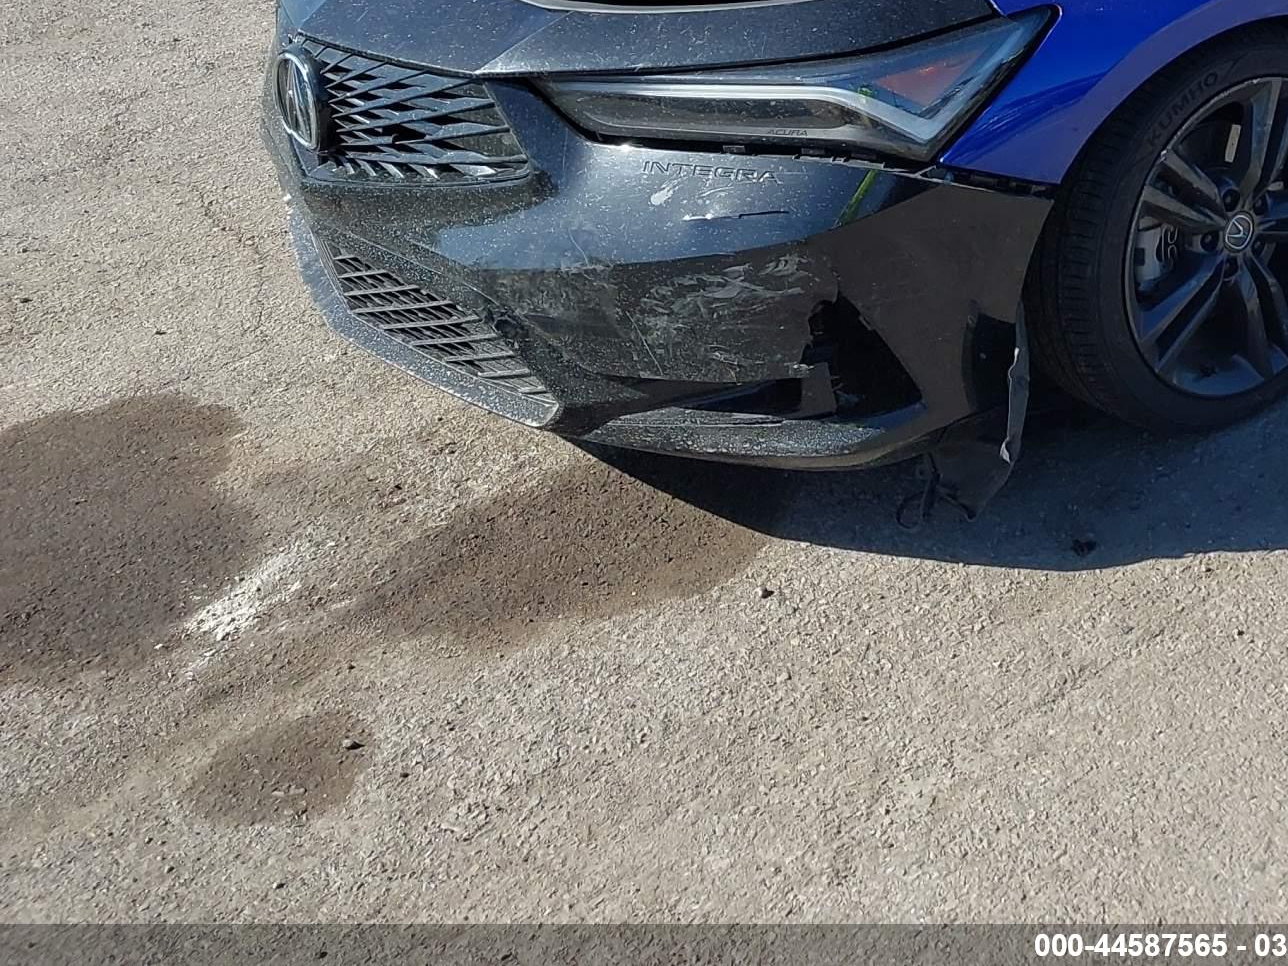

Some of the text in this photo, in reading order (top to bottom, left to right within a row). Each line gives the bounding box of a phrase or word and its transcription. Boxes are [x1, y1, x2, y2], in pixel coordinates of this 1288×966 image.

[1145, 71, 1219, 147] KUMHO
[767, 129, 808, 137] ACURA
[642, 160, 784, 184] INTEGRA
